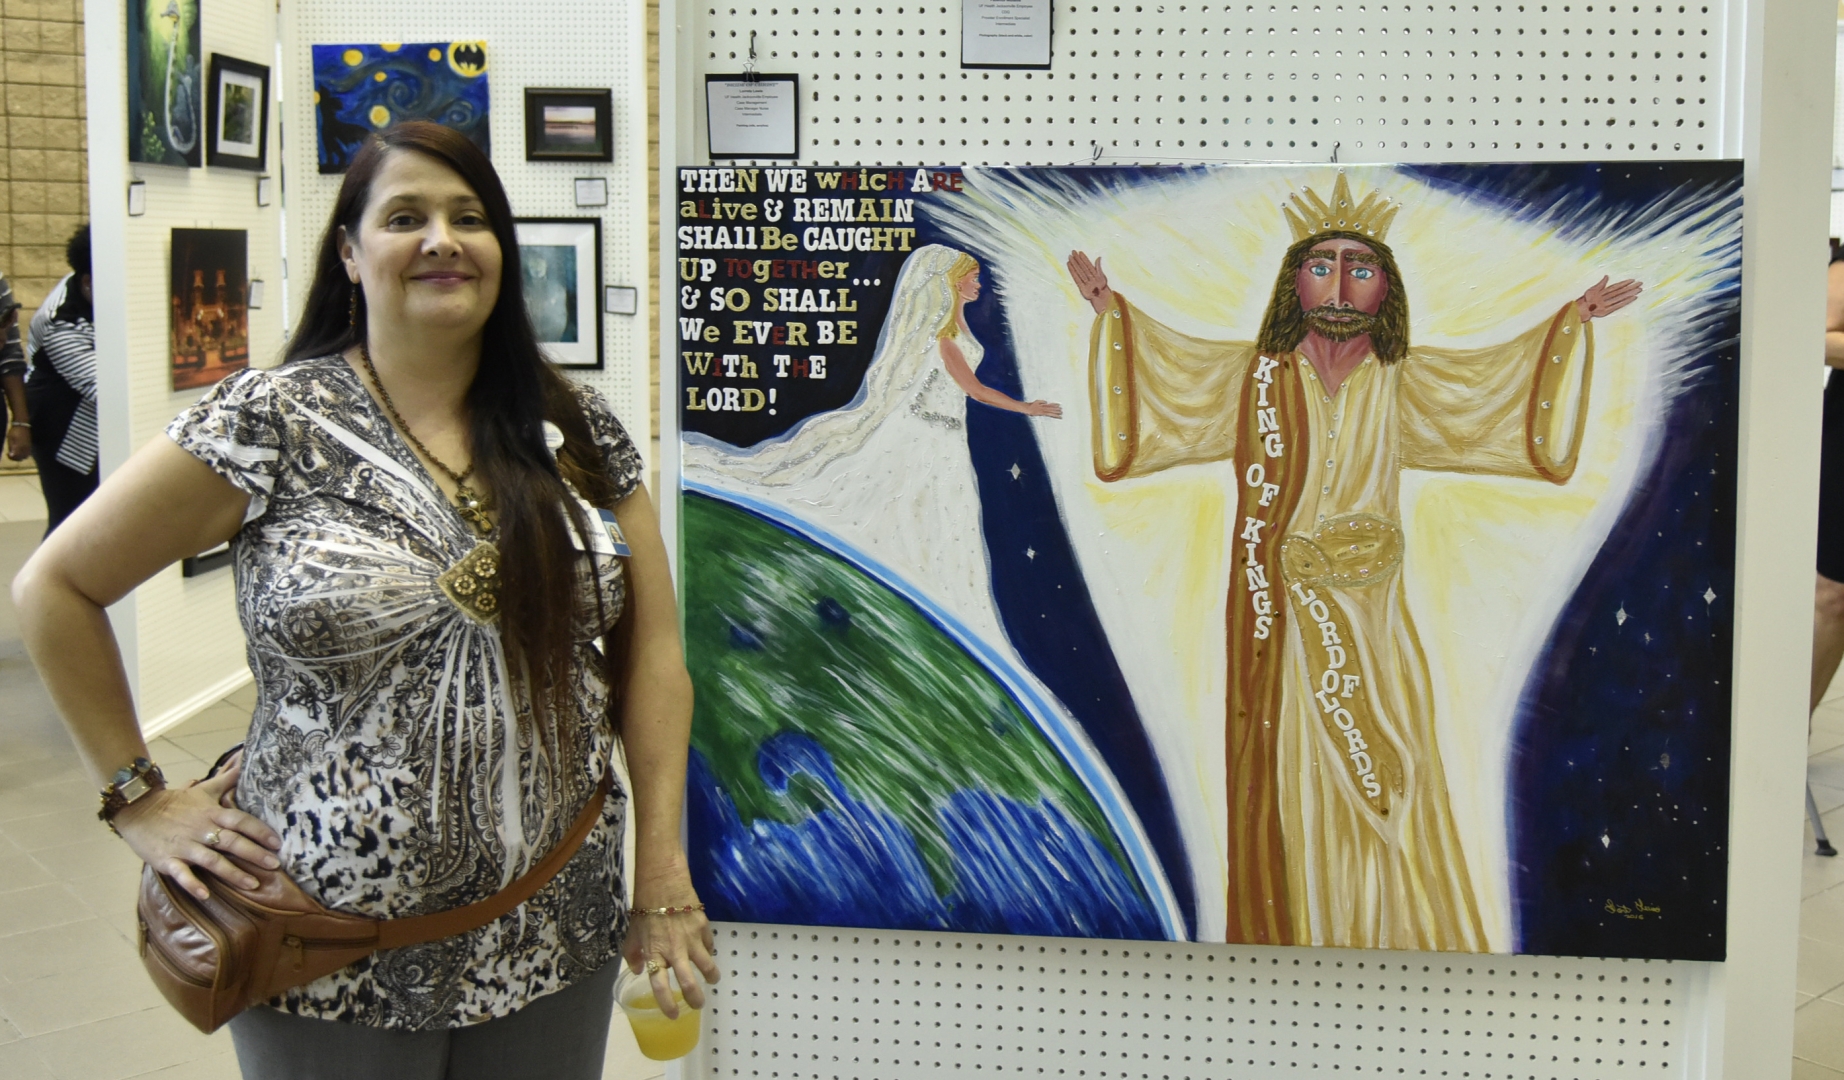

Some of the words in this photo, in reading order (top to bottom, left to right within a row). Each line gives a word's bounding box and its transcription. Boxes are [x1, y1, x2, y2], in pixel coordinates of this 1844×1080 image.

[681, 168, 759, 193] THEN
[764, 168, 808, 193] WE
[911, 168, 964, 193] ARE
[763, 199, 784, 222] &
[793, 198, 915, 222] REMAIN
[760, 226, 799, 250] Be
[803, 226, 916, 251] CAUGHT
[678, 257, 718, 282] UP
[681, 285, 701, 310] &
[710, 287, 751, 312] SO
[763, 288, 858, 312] SHALL
[679, 317, 721, 343] We
[733, 320, 809, 346] EVER
[817, 320, 858, 344] BE
[682, 351, 759, 378] WITh
[773, 354, 827, 379] THE
[686, 387, 777, 416] LORD!
[1252, 355, 1285, 459] KING
[1245, 463, 1280, 507] OF
[1240, 516, 1273, 640] KINGS
[1291, 582, 1347, 669] LORD
[1321, 669, 1360, 699] OF
[1315, 689, 1381, 798] LORDS
